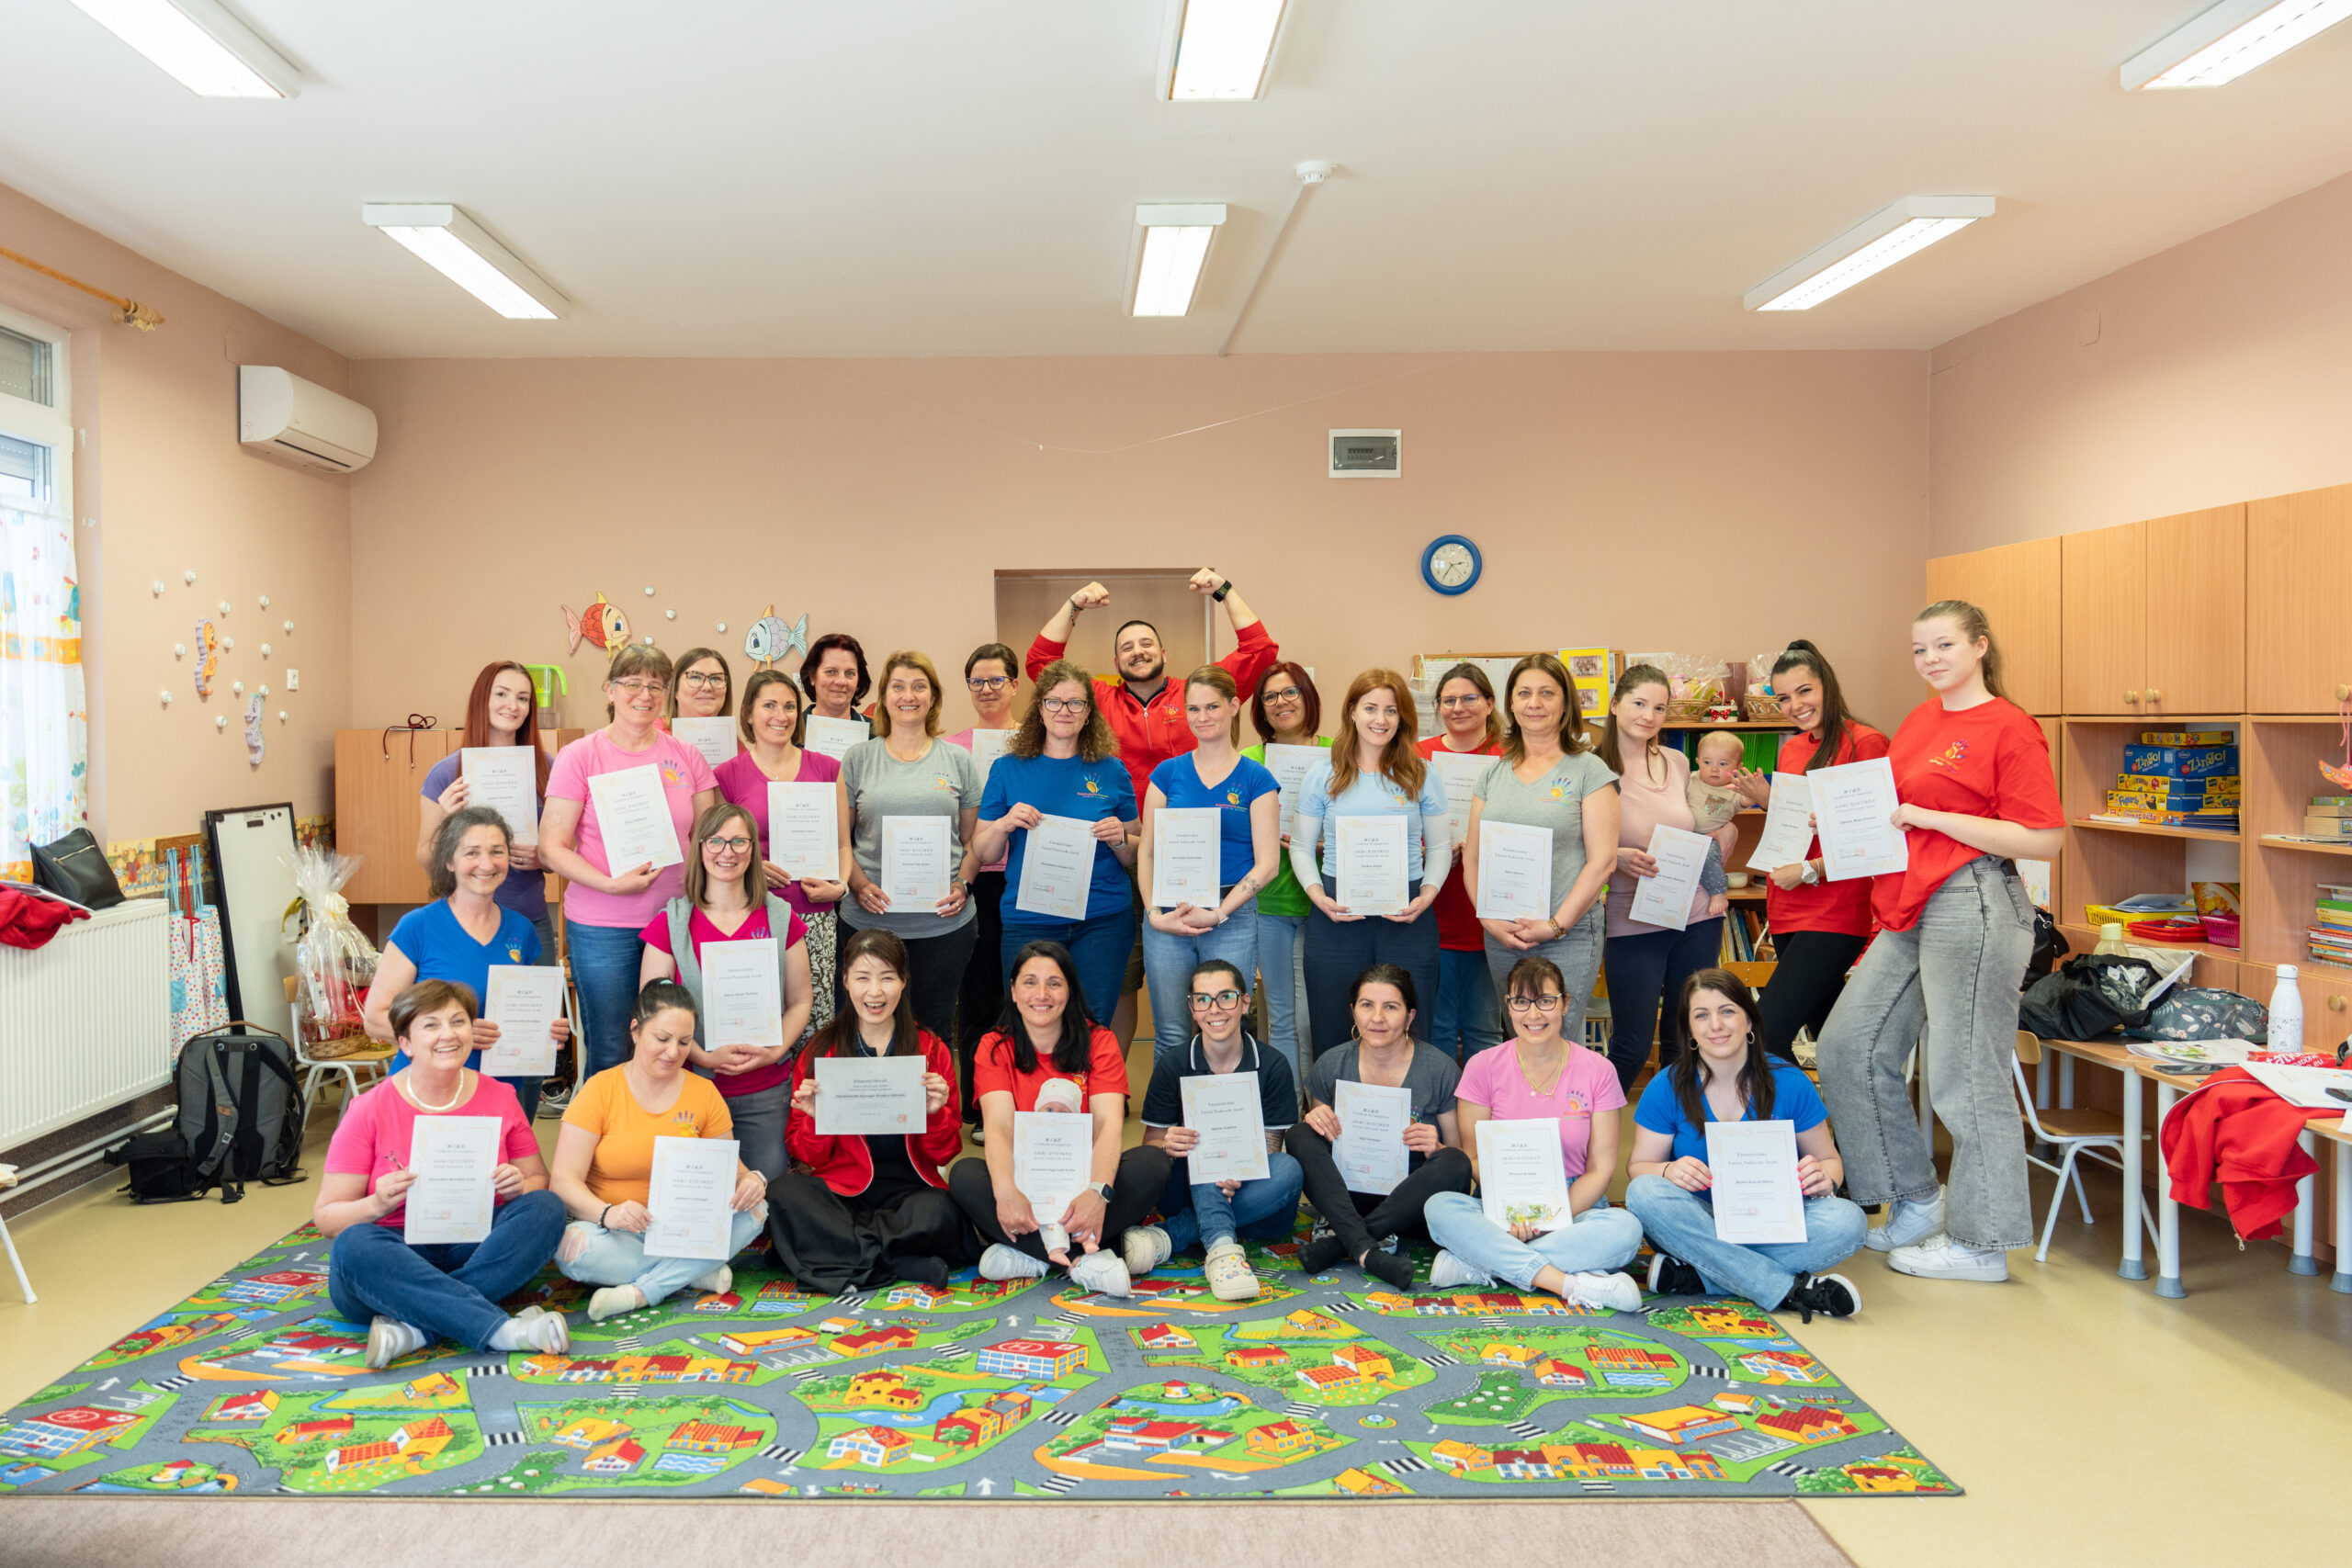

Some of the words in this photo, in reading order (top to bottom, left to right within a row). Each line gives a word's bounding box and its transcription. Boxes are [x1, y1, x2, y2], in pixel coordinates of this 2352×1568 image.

[2135, 750, 2161, 771] Zingo!
[2187, 750, 2226, 772] Zingo!
[1008, 1342, 1033, 1350] H
[58, 1410, 88, 1420] H
